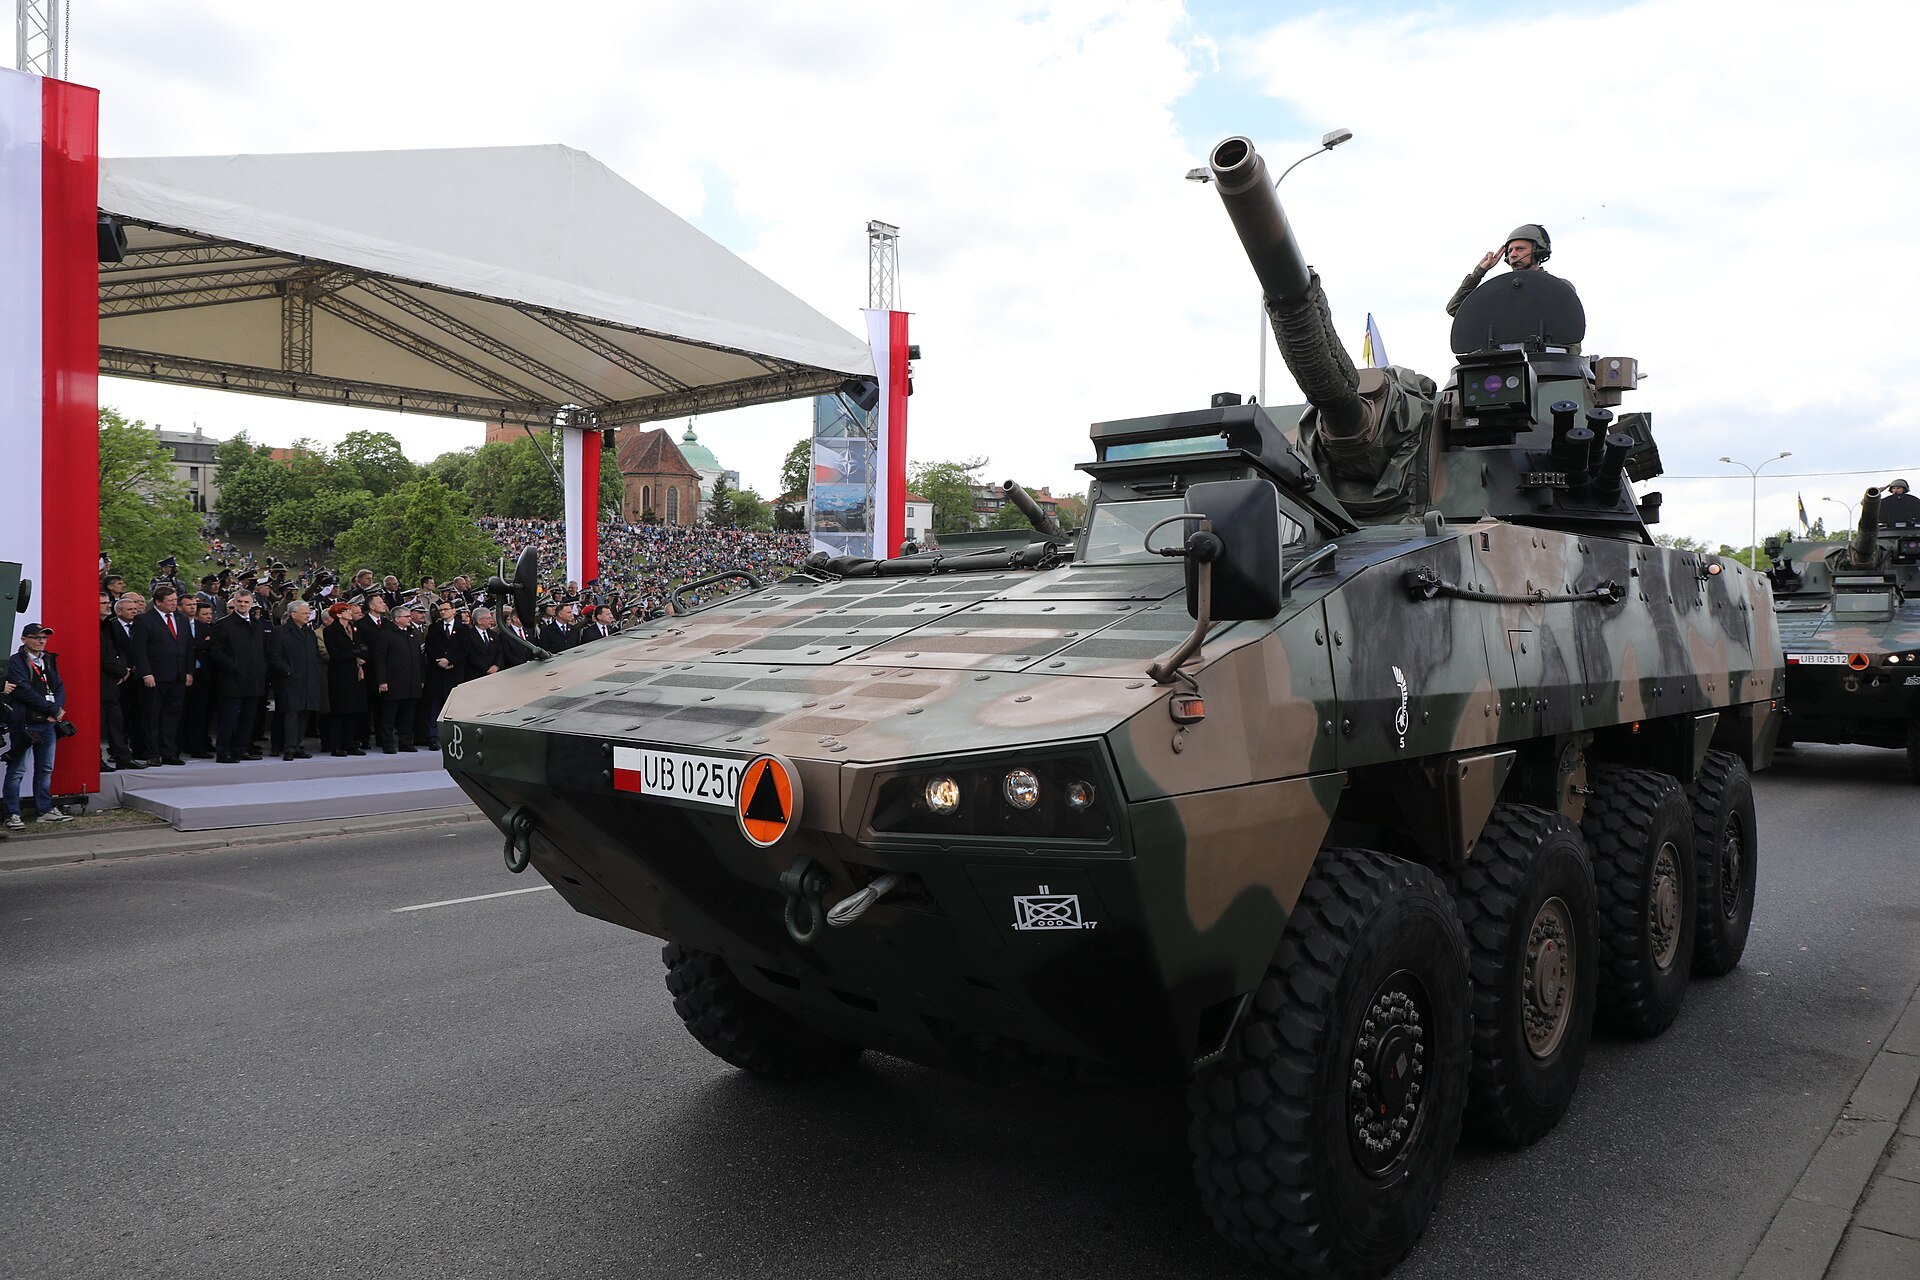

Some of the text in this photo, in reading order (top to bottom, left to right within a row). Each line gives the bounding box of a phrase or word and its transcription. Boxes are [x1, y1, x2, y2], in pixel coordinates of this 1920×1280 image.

[1800, 655, 1848, 664] UB 02512
[1399, 736, 1406, 749] 5
[644, 755, 675, 791] UB
[1082, 921, 1098, 930] 17
